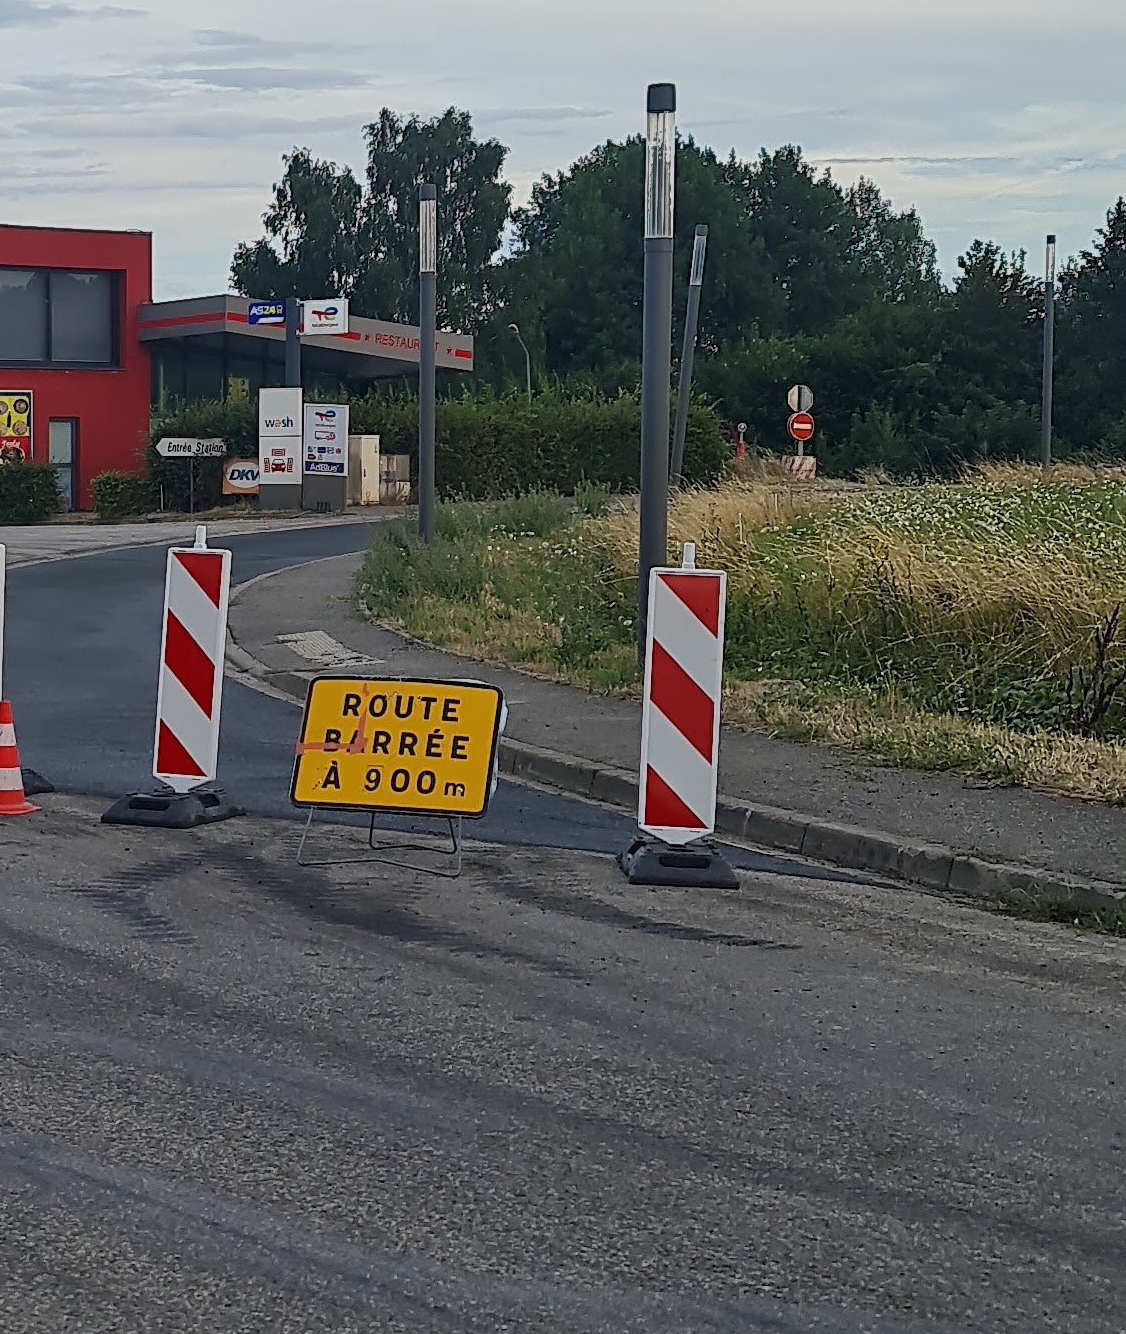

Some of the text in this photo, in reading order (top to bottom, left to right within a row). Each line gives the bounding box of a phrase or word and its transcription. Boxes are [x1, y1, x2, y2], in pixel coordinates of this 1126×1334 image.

[249, 305, 276, 316] AS24
[374, 332, 440, 351] RESTAURT
[264, 415, 294, 428] wash
[167, 441, 224, 453] Entrée Station
[229, 468, 260, 481] DKV
[342, 693, 461, 722] ROUTE
[321, 760, 341, 790] À
